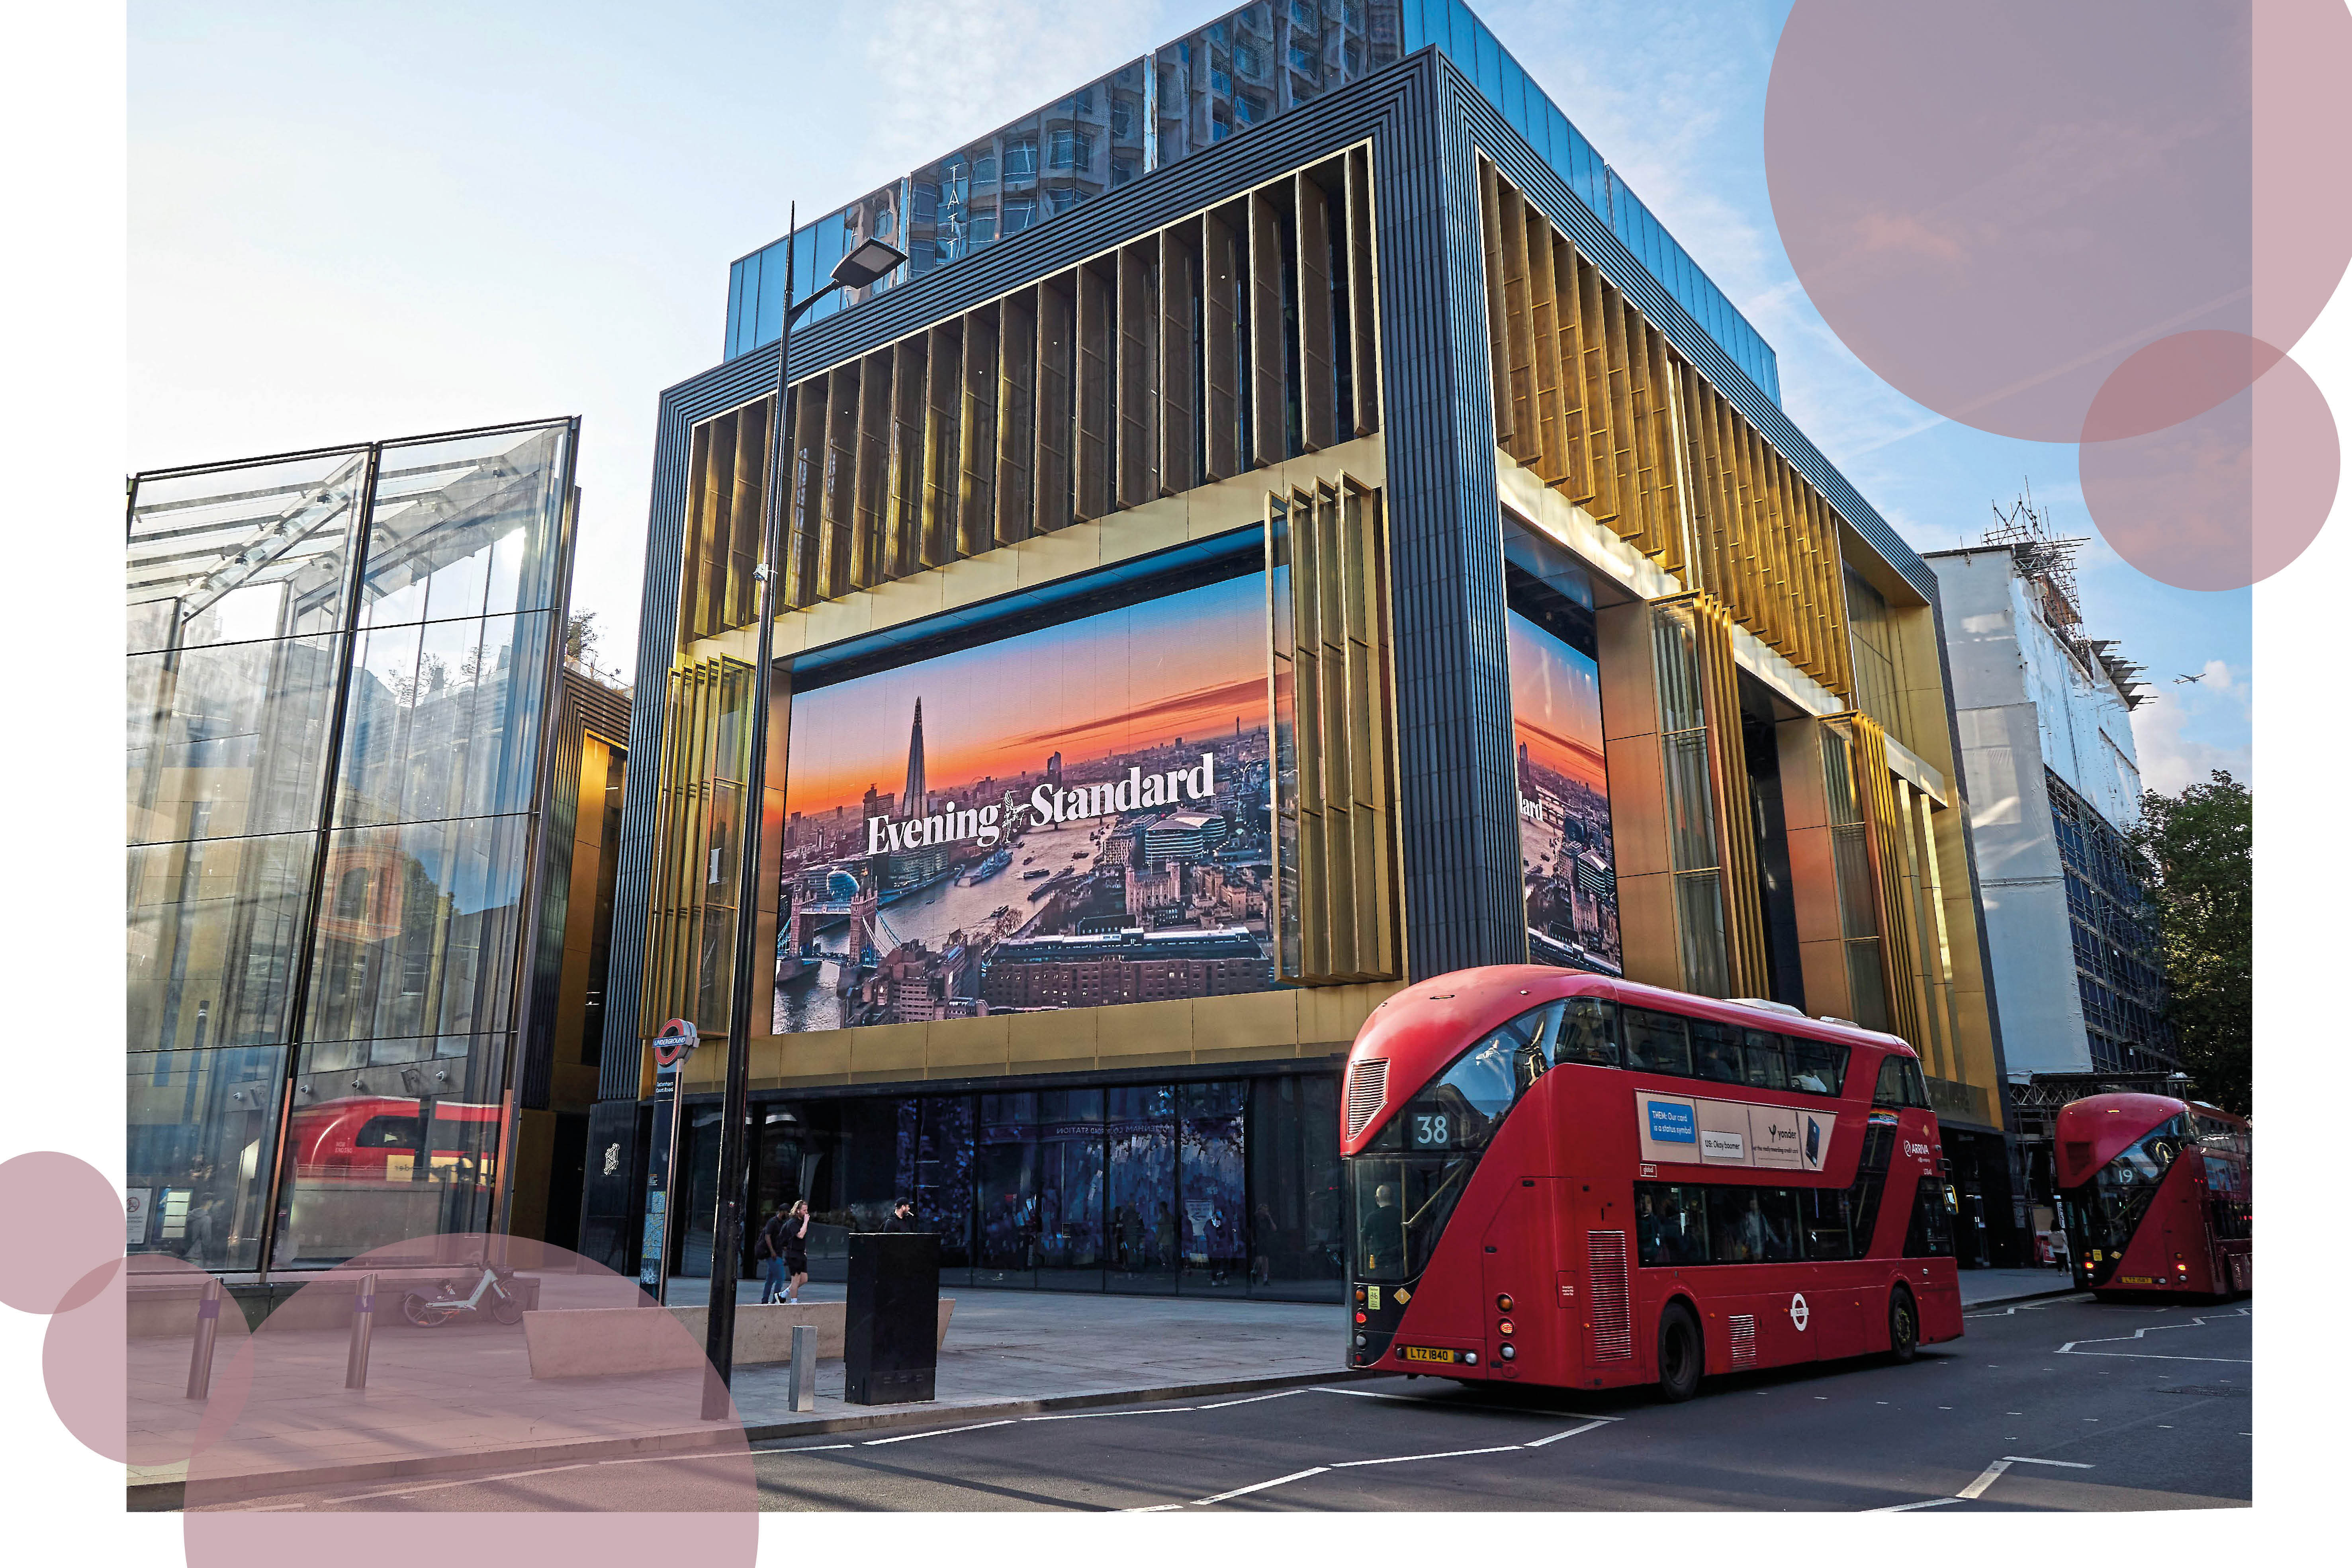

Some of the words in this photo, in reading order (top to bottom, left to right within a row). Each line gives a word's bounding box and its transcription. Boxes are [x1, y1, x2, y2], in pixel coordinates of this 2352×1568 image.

[867, 801, 1001, 856] Evening
[1029, 752, 1216, 827] Standard
[654, 1037, 685, 1046] UNDERGROUND
[1652, 1110, 1667, 1120] THEM:
[1668, 1113, 1677, 1121] Our
[1417, 1115, 1448, 1144] 38
[1662, 1124, 1676, 1133] status
[1777, 1129, 1796, 1141] yonder
[1713, 1140, 1724, 1150] Okay
[1724, 1141, 1740, 1149] boomer
[1912, 1144, 1929, 1154] ARRIVA
[2119, 1169, 2133, 1183] 19
[1411, 1348, 1427, 1359] LTZ
[1429, 1349, 1448, 1361] 1840
